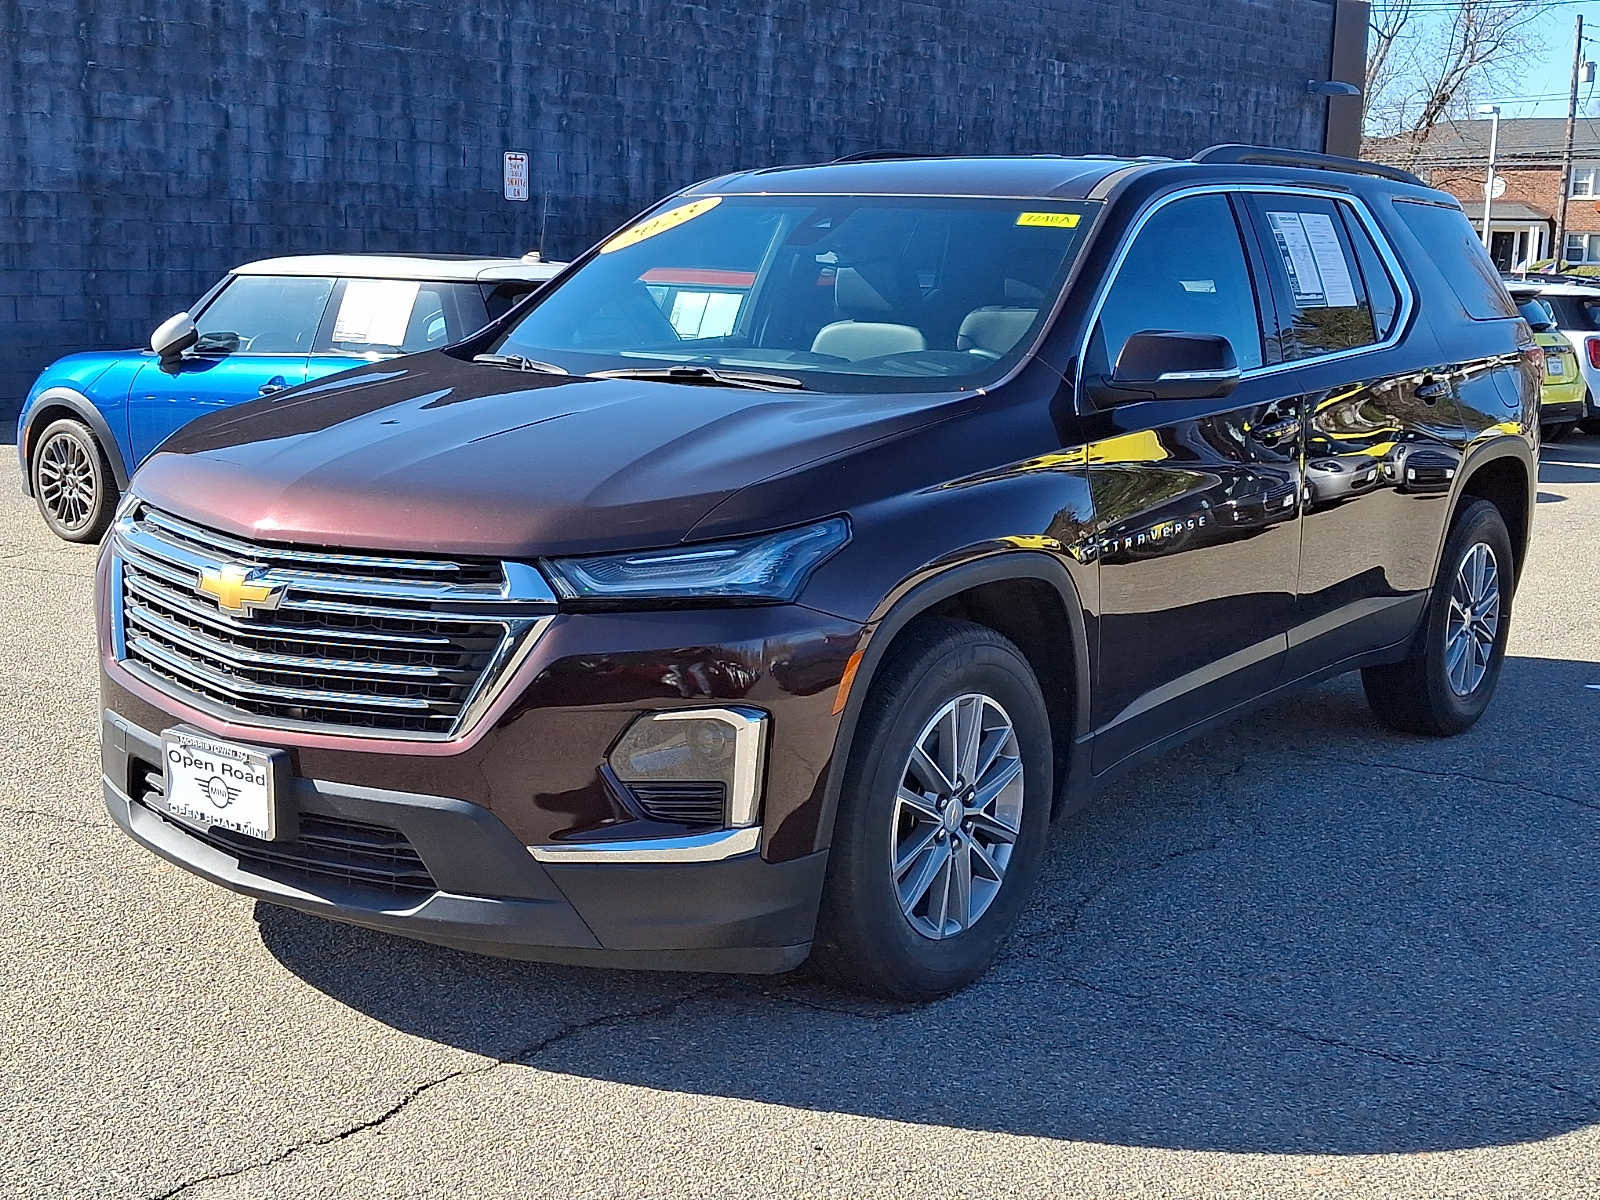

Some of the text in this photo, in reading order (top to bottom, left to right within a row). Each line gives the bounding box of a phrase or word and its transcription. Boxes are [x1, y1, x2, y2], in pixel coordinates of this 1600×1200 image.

[1113, 516, 1207, 552] TRAVERSE
[169, 749, 265, 786] Open Road
[210, 786, 228, 798] MINI
[168, 802, 267, 839] OPEN ROAD MINI
